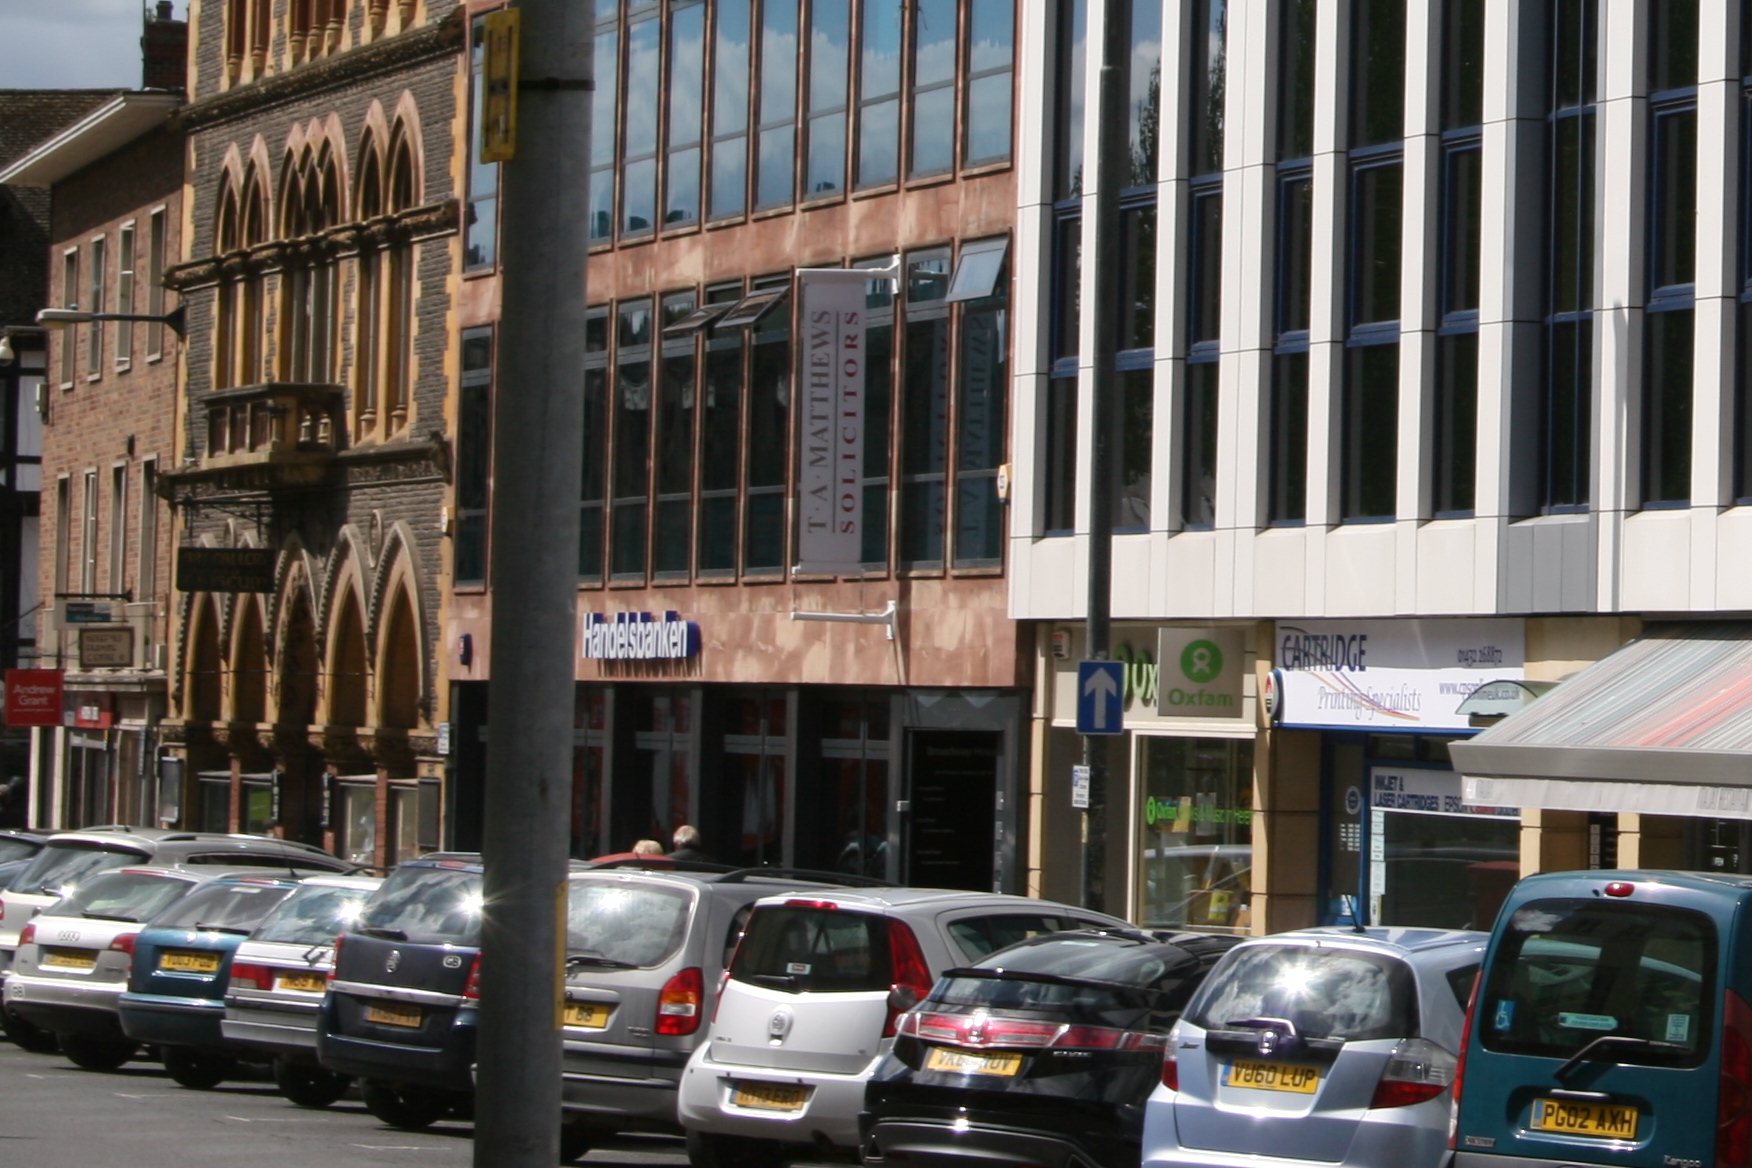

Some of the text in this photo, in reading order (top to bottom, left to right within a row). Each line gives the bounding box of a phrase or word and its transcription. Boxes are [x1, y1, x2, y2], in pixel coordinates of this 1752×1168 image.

[809, 310, 832, 468] MATTHEWS
[840, 311, 860, 535] SOLICITORS
[582, 610, 688, 660] Handelsbanken
[1282, 633, 1368, 672] CARTRIDGE
[13, 684, 56, 695] Andrew
[18, 696, 49, 706] Grant
[1168, 687, 1233, 707] Oxfam
[1279, 1064, 1318, 1089] LUP
[1542, 1103, 1634, 1133] PG02 AXH
